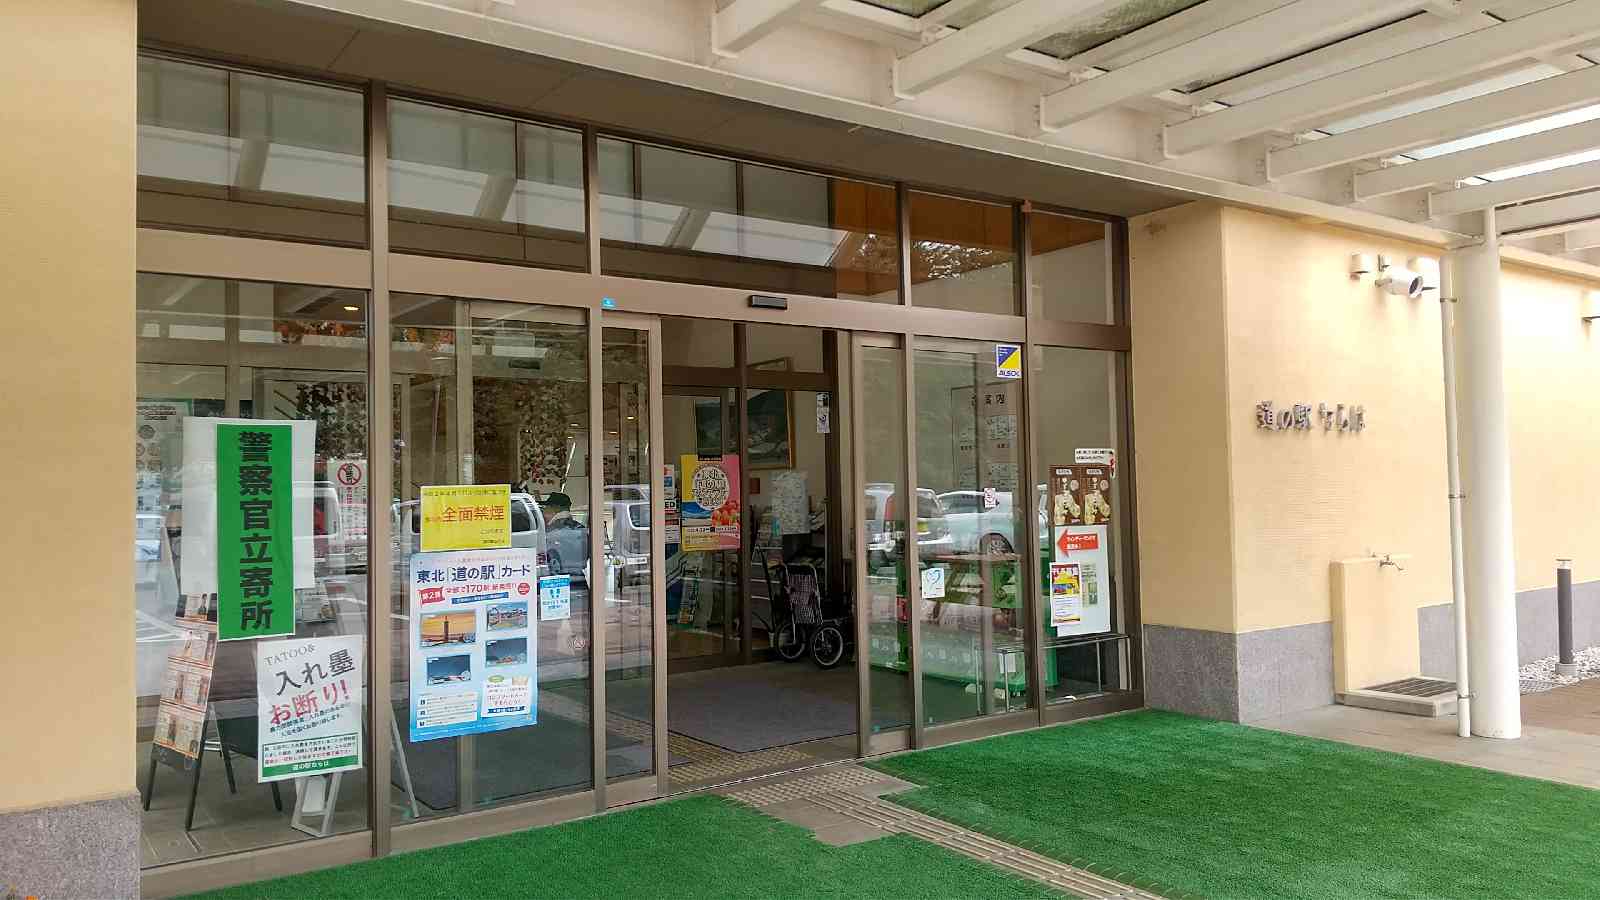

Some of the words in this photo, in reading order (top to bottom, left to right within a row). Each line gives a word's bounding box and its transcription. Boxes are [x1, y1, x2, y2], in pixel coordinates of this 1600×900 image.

[1255, 400, 1312, 432] 道の駅
[441, 505, 505, 521] 全面禁煙
[239, 431, 273, 630] 警察官立寄所
[416, 564, 531, 584] 東北「道の駅」カード
[264, 643, 316, 666] TATOO&
[276, 648, 356, 696] 入れ墨
[270, 679, 349, 725] お断り!
